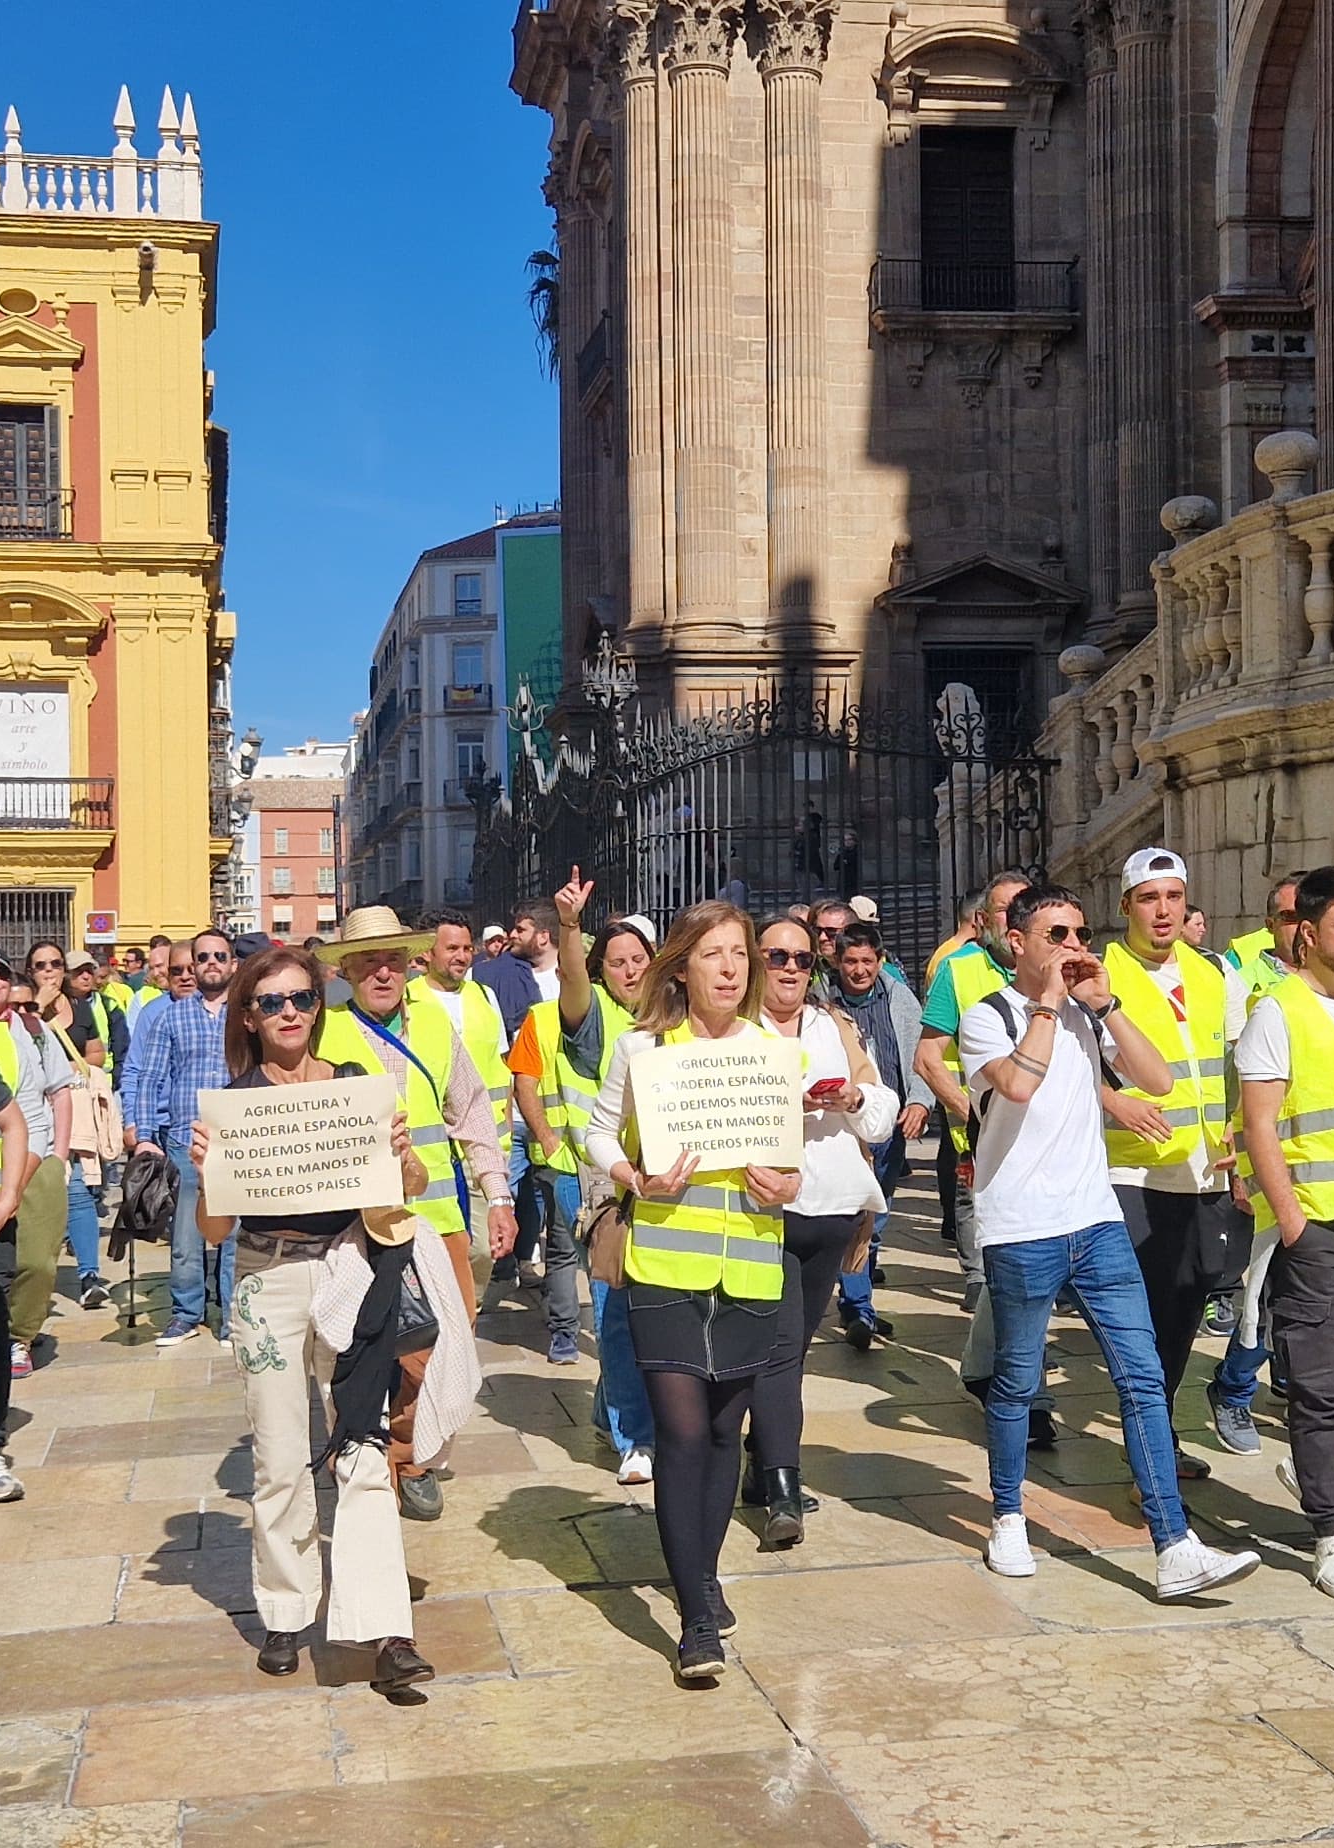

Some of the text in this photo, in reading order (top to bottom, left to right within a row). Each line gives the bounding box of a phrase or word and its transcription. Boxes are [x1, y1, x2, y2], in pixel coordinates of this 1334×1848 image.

[11, 725, 37, 735] arte
[19, 742, 27, 753] y
[760, 1055, 768, 1065] Y
[728, 1073, 789, 1087] ESPAÑOLA,
[244, 1096, 351, 1118] AGRICULTURA Y
[657, 1095, 789, 1113] NO DEJEMOS NUESTRA
[220, 1114, 378, 1140] GANADERIA ESPAÑOLA,
[668, 1115, 785, 1133] MESA EN MANOS DE
[224, 1135, 377, 1160] NO DEJEMOS NUESTRA
[679, 1136, 780, 1152] TERCEROS PAISES
[234, 1155, 370, 1180] MESA EN MANOS DE
[245, 1176, 361, 1198] TERCEROS PAISES
